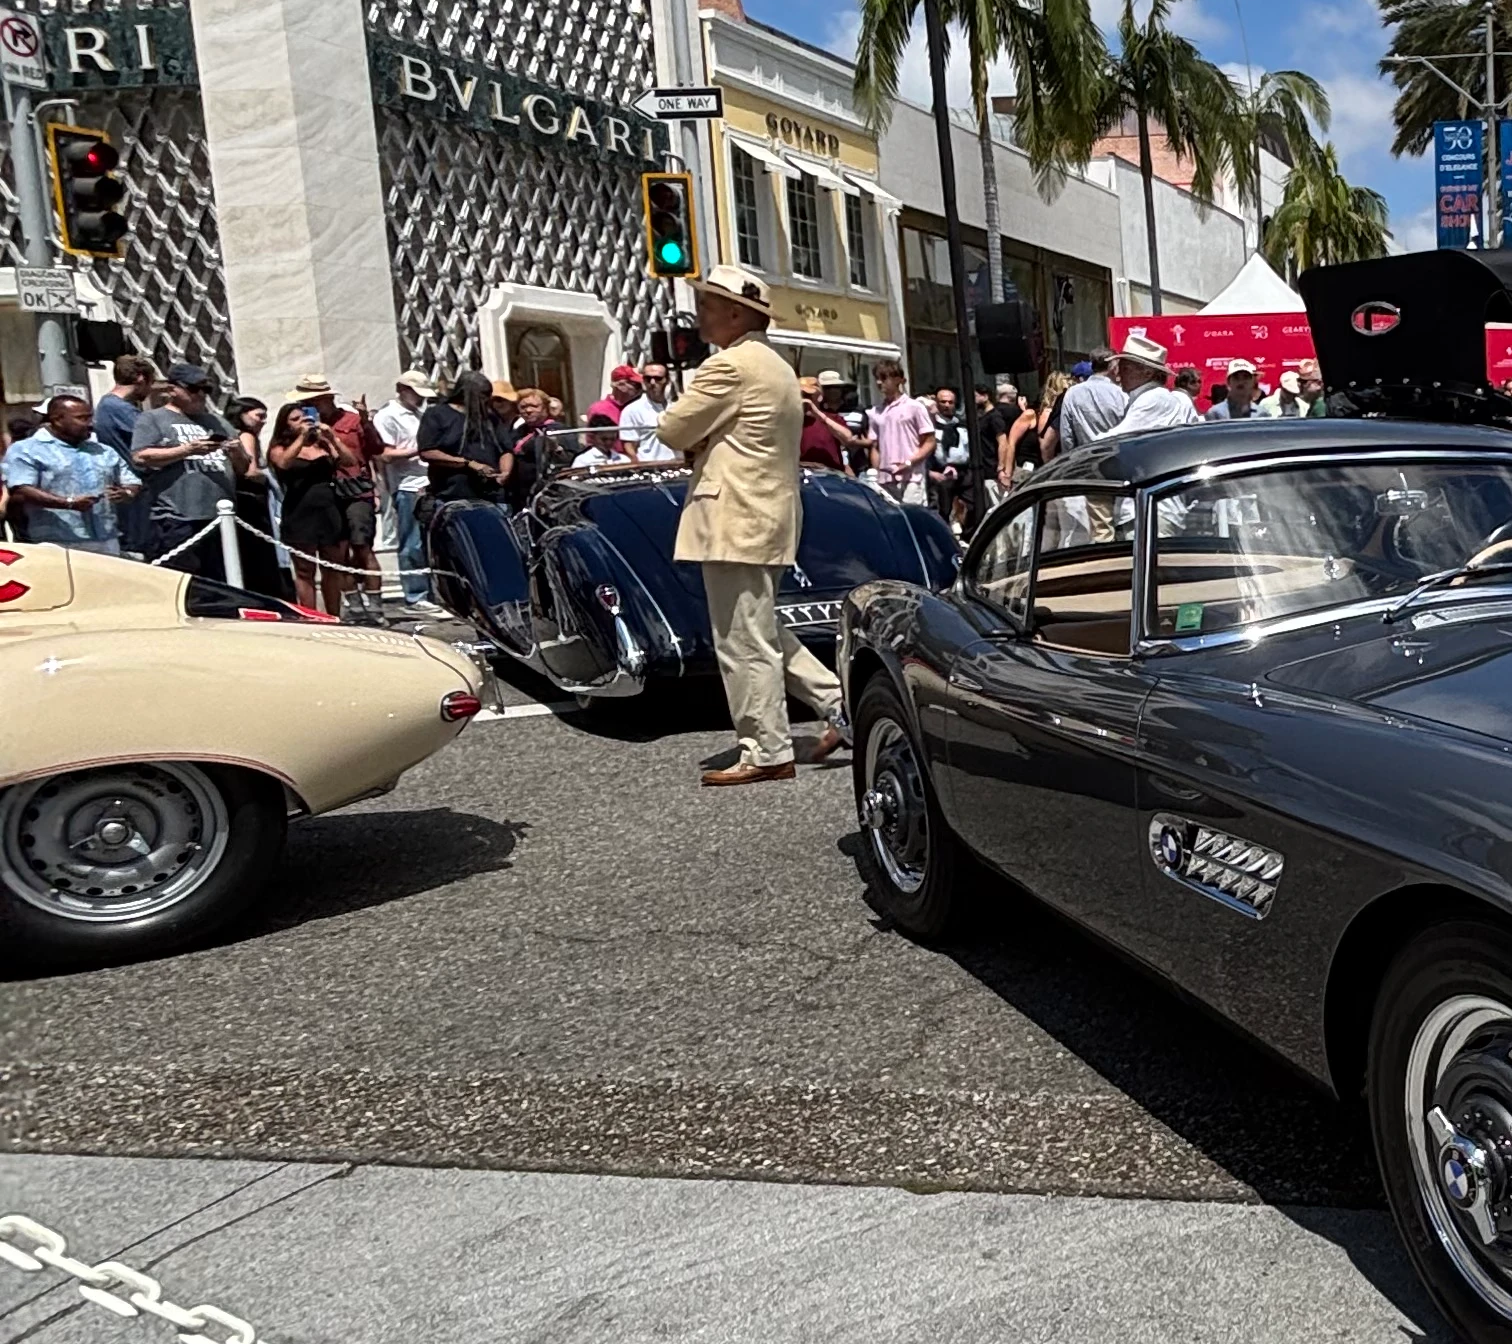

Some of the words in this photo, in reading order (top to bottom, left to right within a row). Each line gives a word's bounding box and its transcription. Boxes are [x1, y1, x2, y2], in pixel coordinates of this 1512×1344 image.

[45, 24, 158, 73] RI
[398, 53, 657, 162] BVLGARI
[658, 96, 683, 111] ONE
[687, 95, 712, 110] WAY
[765, 111, 840, 153] GOYARD
[1442, 126, 1473, 151] 50
[1440, 194, 1479, 213] CAR
[24, 292, 47, 307] OK
[171, 423, 208, 437] THIS
